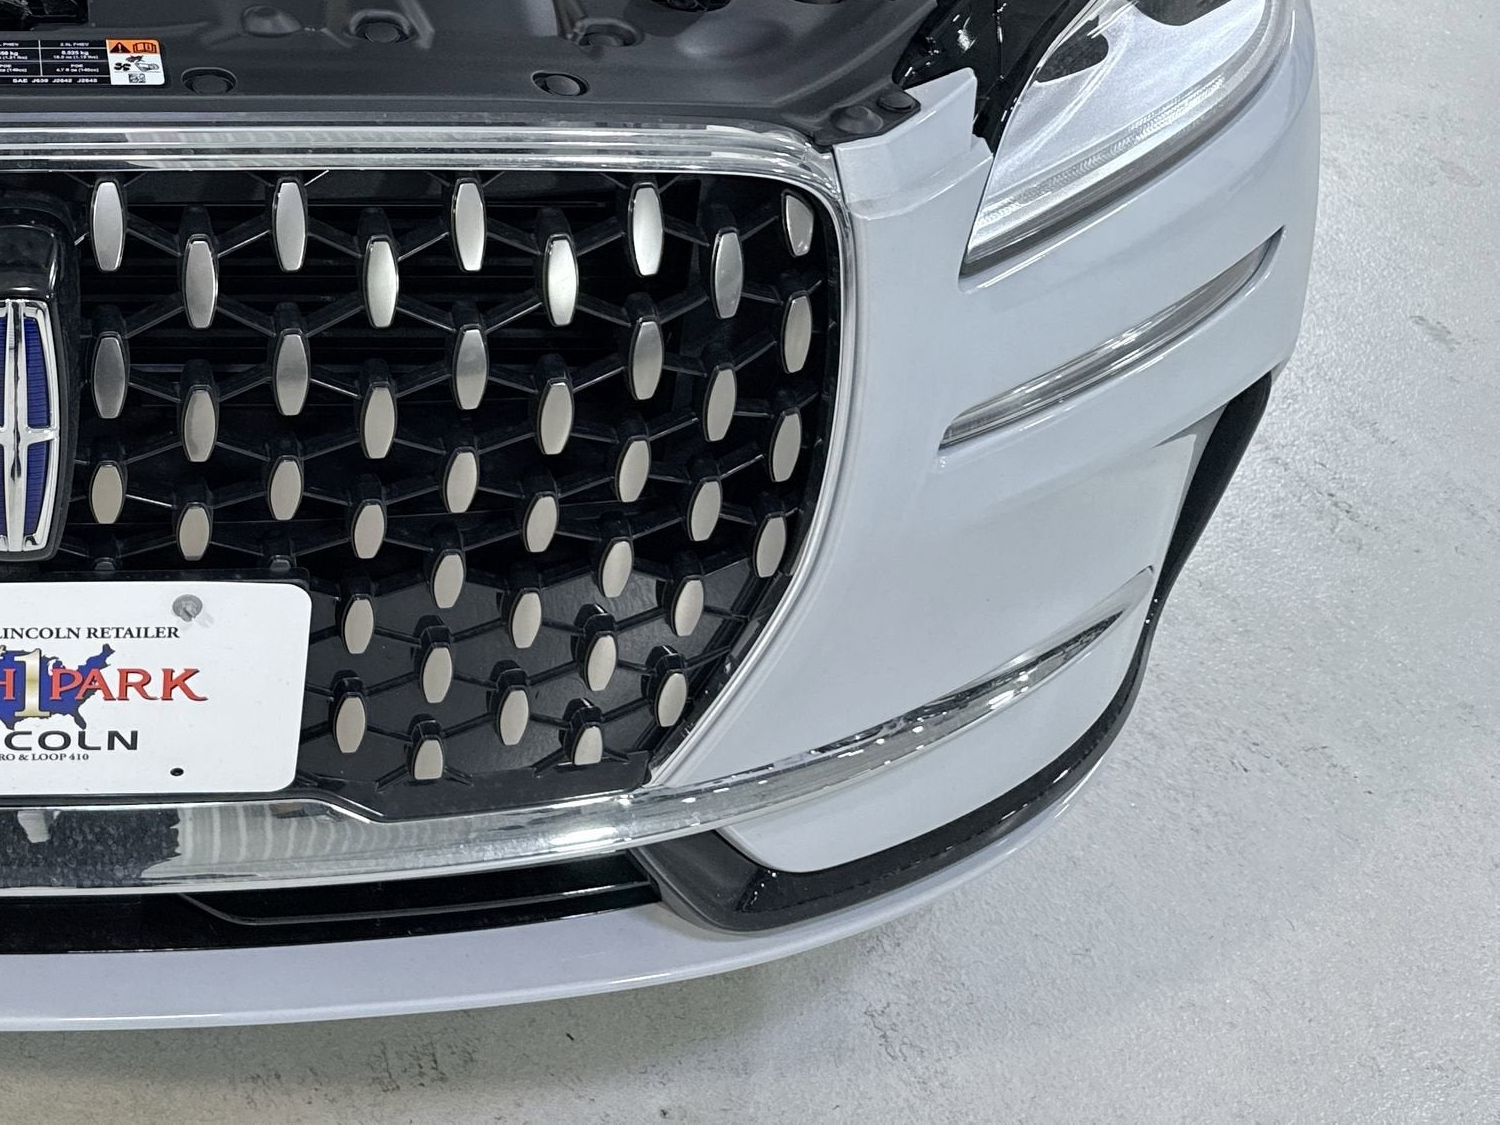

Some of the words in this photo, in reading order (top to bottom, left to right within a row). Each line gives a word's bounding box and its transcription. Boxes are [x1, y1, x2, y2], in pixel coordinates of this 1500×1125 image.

[86, 626, 180, 639] RETAILER
[50, 667, 208, 702] PARK
[18, 753, 29, 761] &
[31, 753, 67, 761] LOOP
